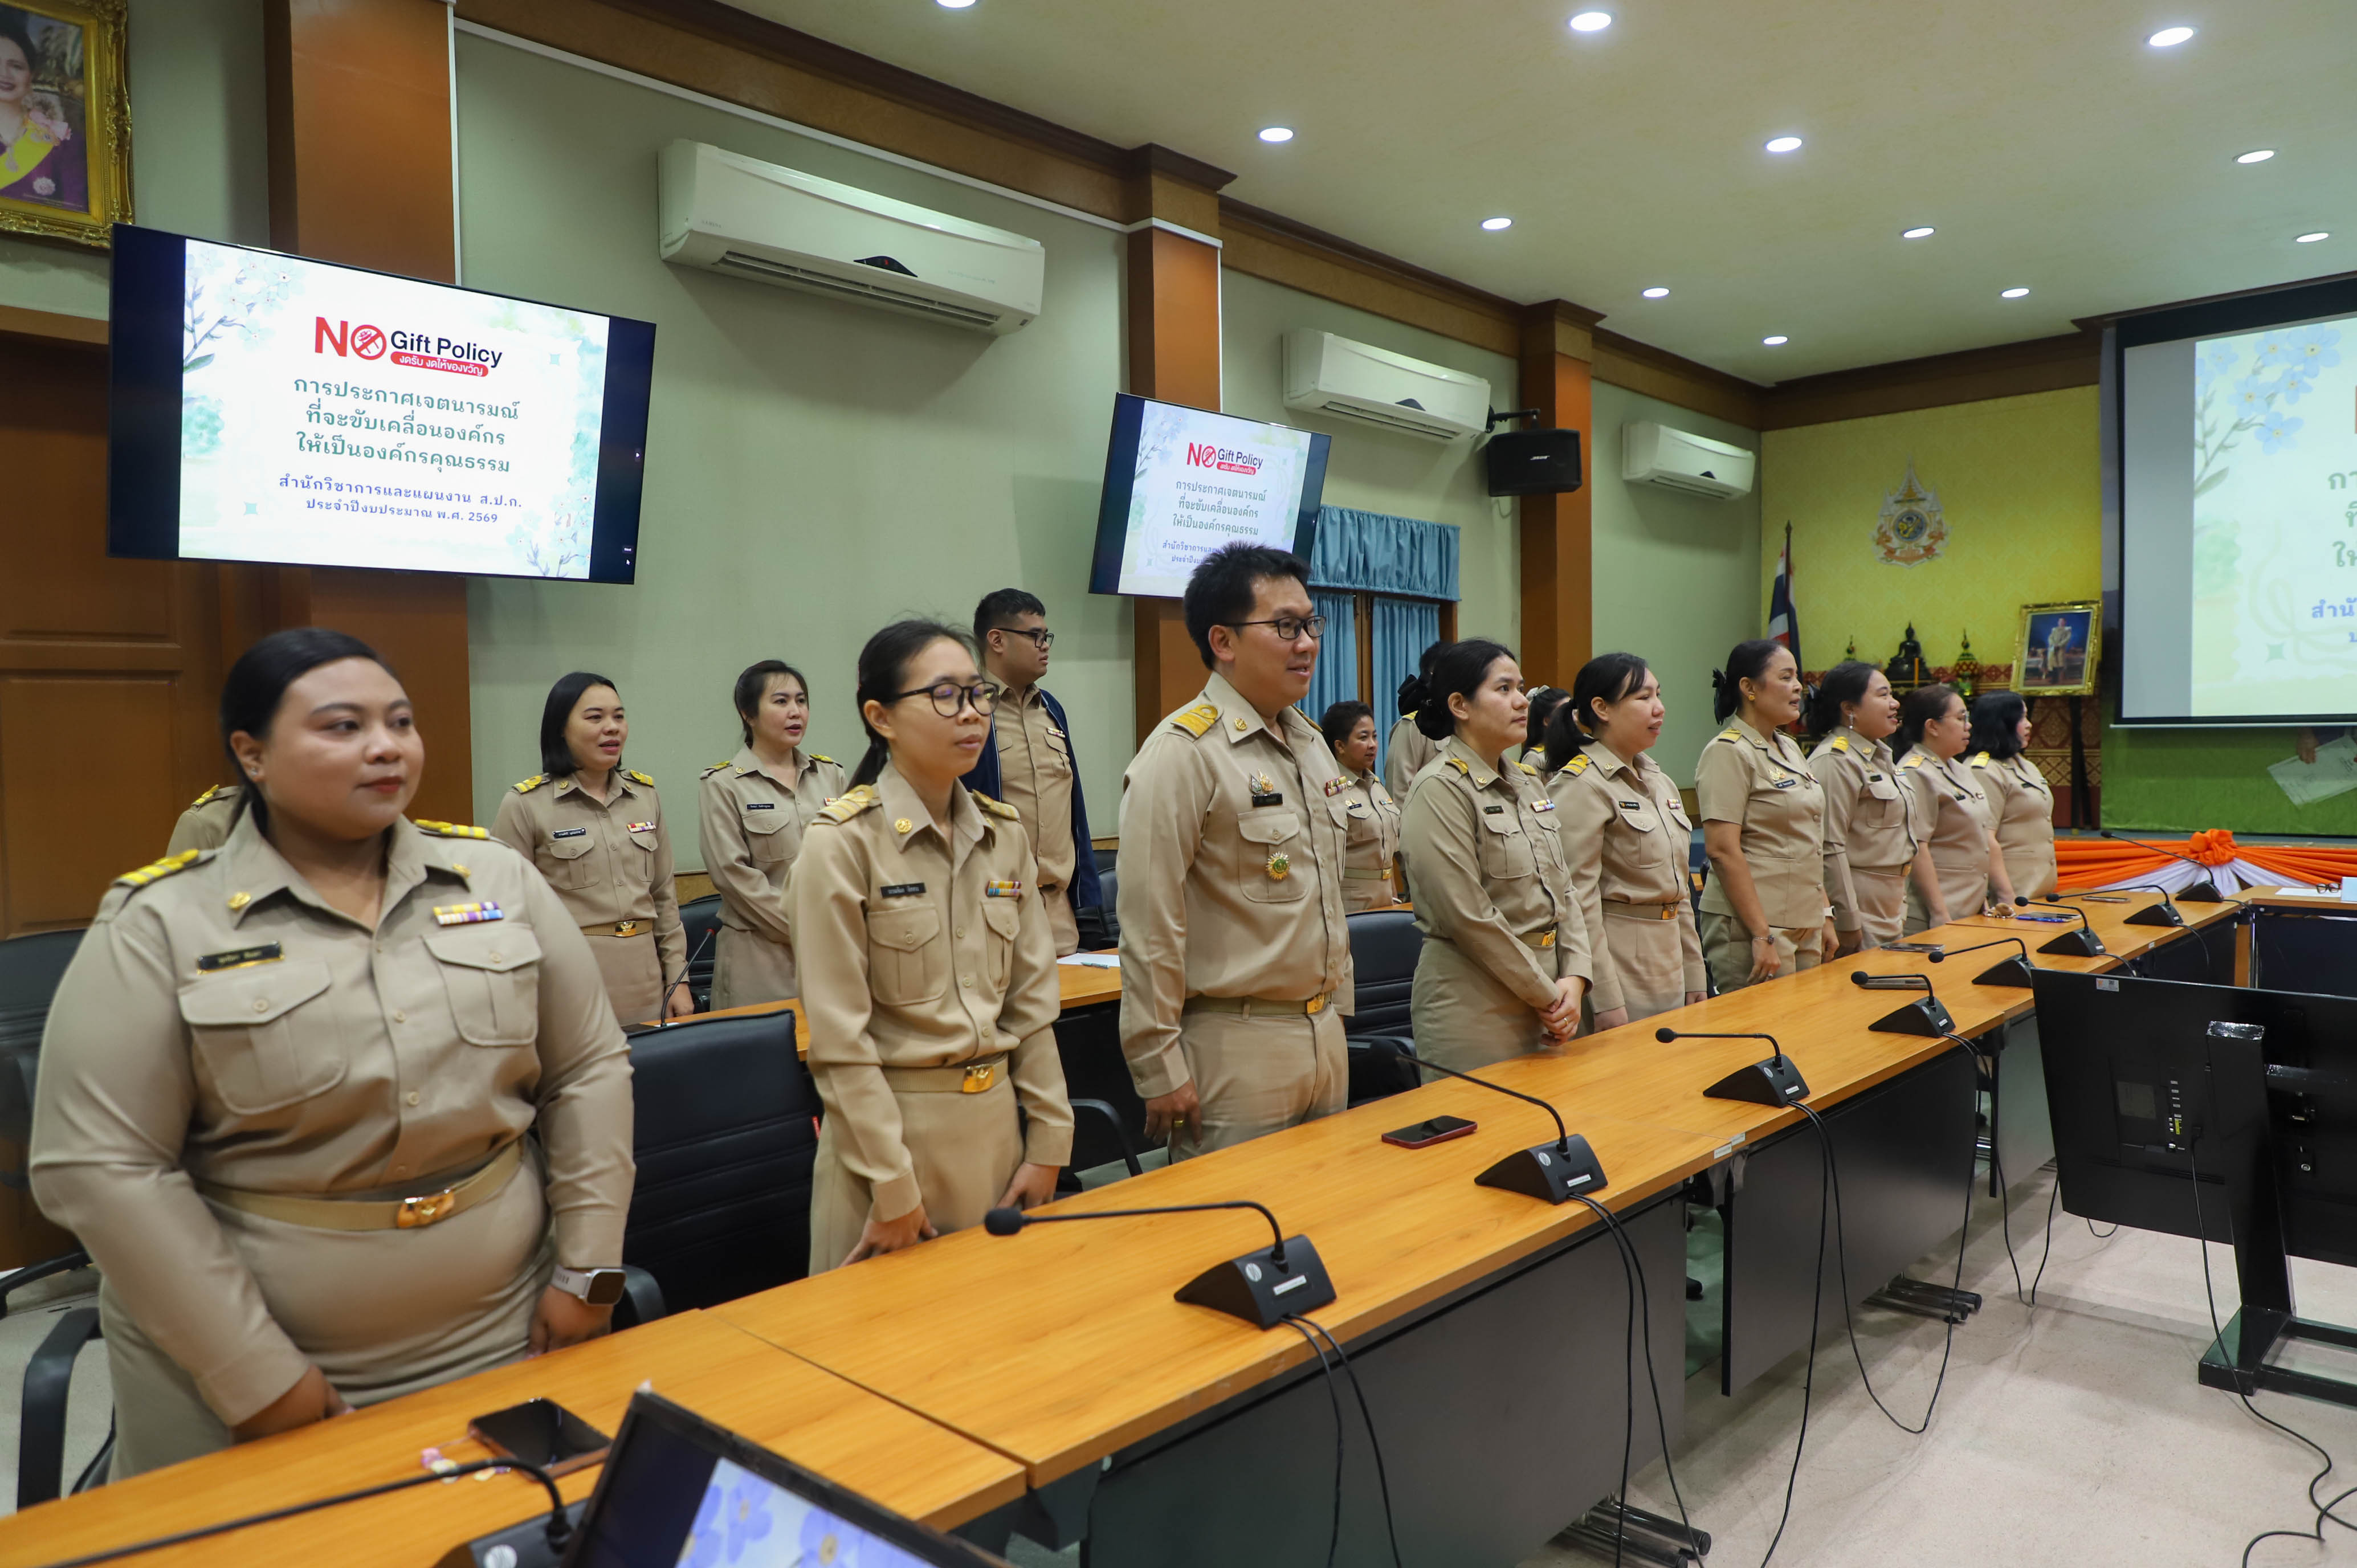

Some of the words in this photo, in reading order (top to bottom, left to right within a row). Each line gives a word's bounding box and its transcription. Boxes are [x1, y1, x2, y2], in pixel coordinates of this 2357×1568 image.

[390, 330, 431, 354] Gift
[437, 337, 503, 368] Policy
[399, 354, 424, 366] งดรับ
[425, 357, 483, 376] งดให้ของขวัญ
[293, 379, 520, 419] การประกาศเจตนารมณ์
[306, 398, 505, 444] ที่จะขับเคลื่อนองค์กร
[296, 431, 509, 472] ให้เป็นองค์กรคุณธรรม
[1218, 448, 1234, 462] Gift
[1235, 451, 1263, 469] Policy
[279, 473, 471, 503] สำนักวิชาการและแผนงาน
[480, 494, 522, 508] ส.ป.ก.
[1176, 481, 1267, 501] การประกาศเจตนารมณ์
[307, 498, 432, 518] ประจำปีงบประมาณ
[437, 510, 463, 520] พ.ศ.
[468, 512, 498, 523] 2569
[1178, 492, 1258, 518] ที่จะขับเคลื่อนองค์กร
[1173, 513, 1258, 537] ให้เป็นองค์กรคุณธรรม
